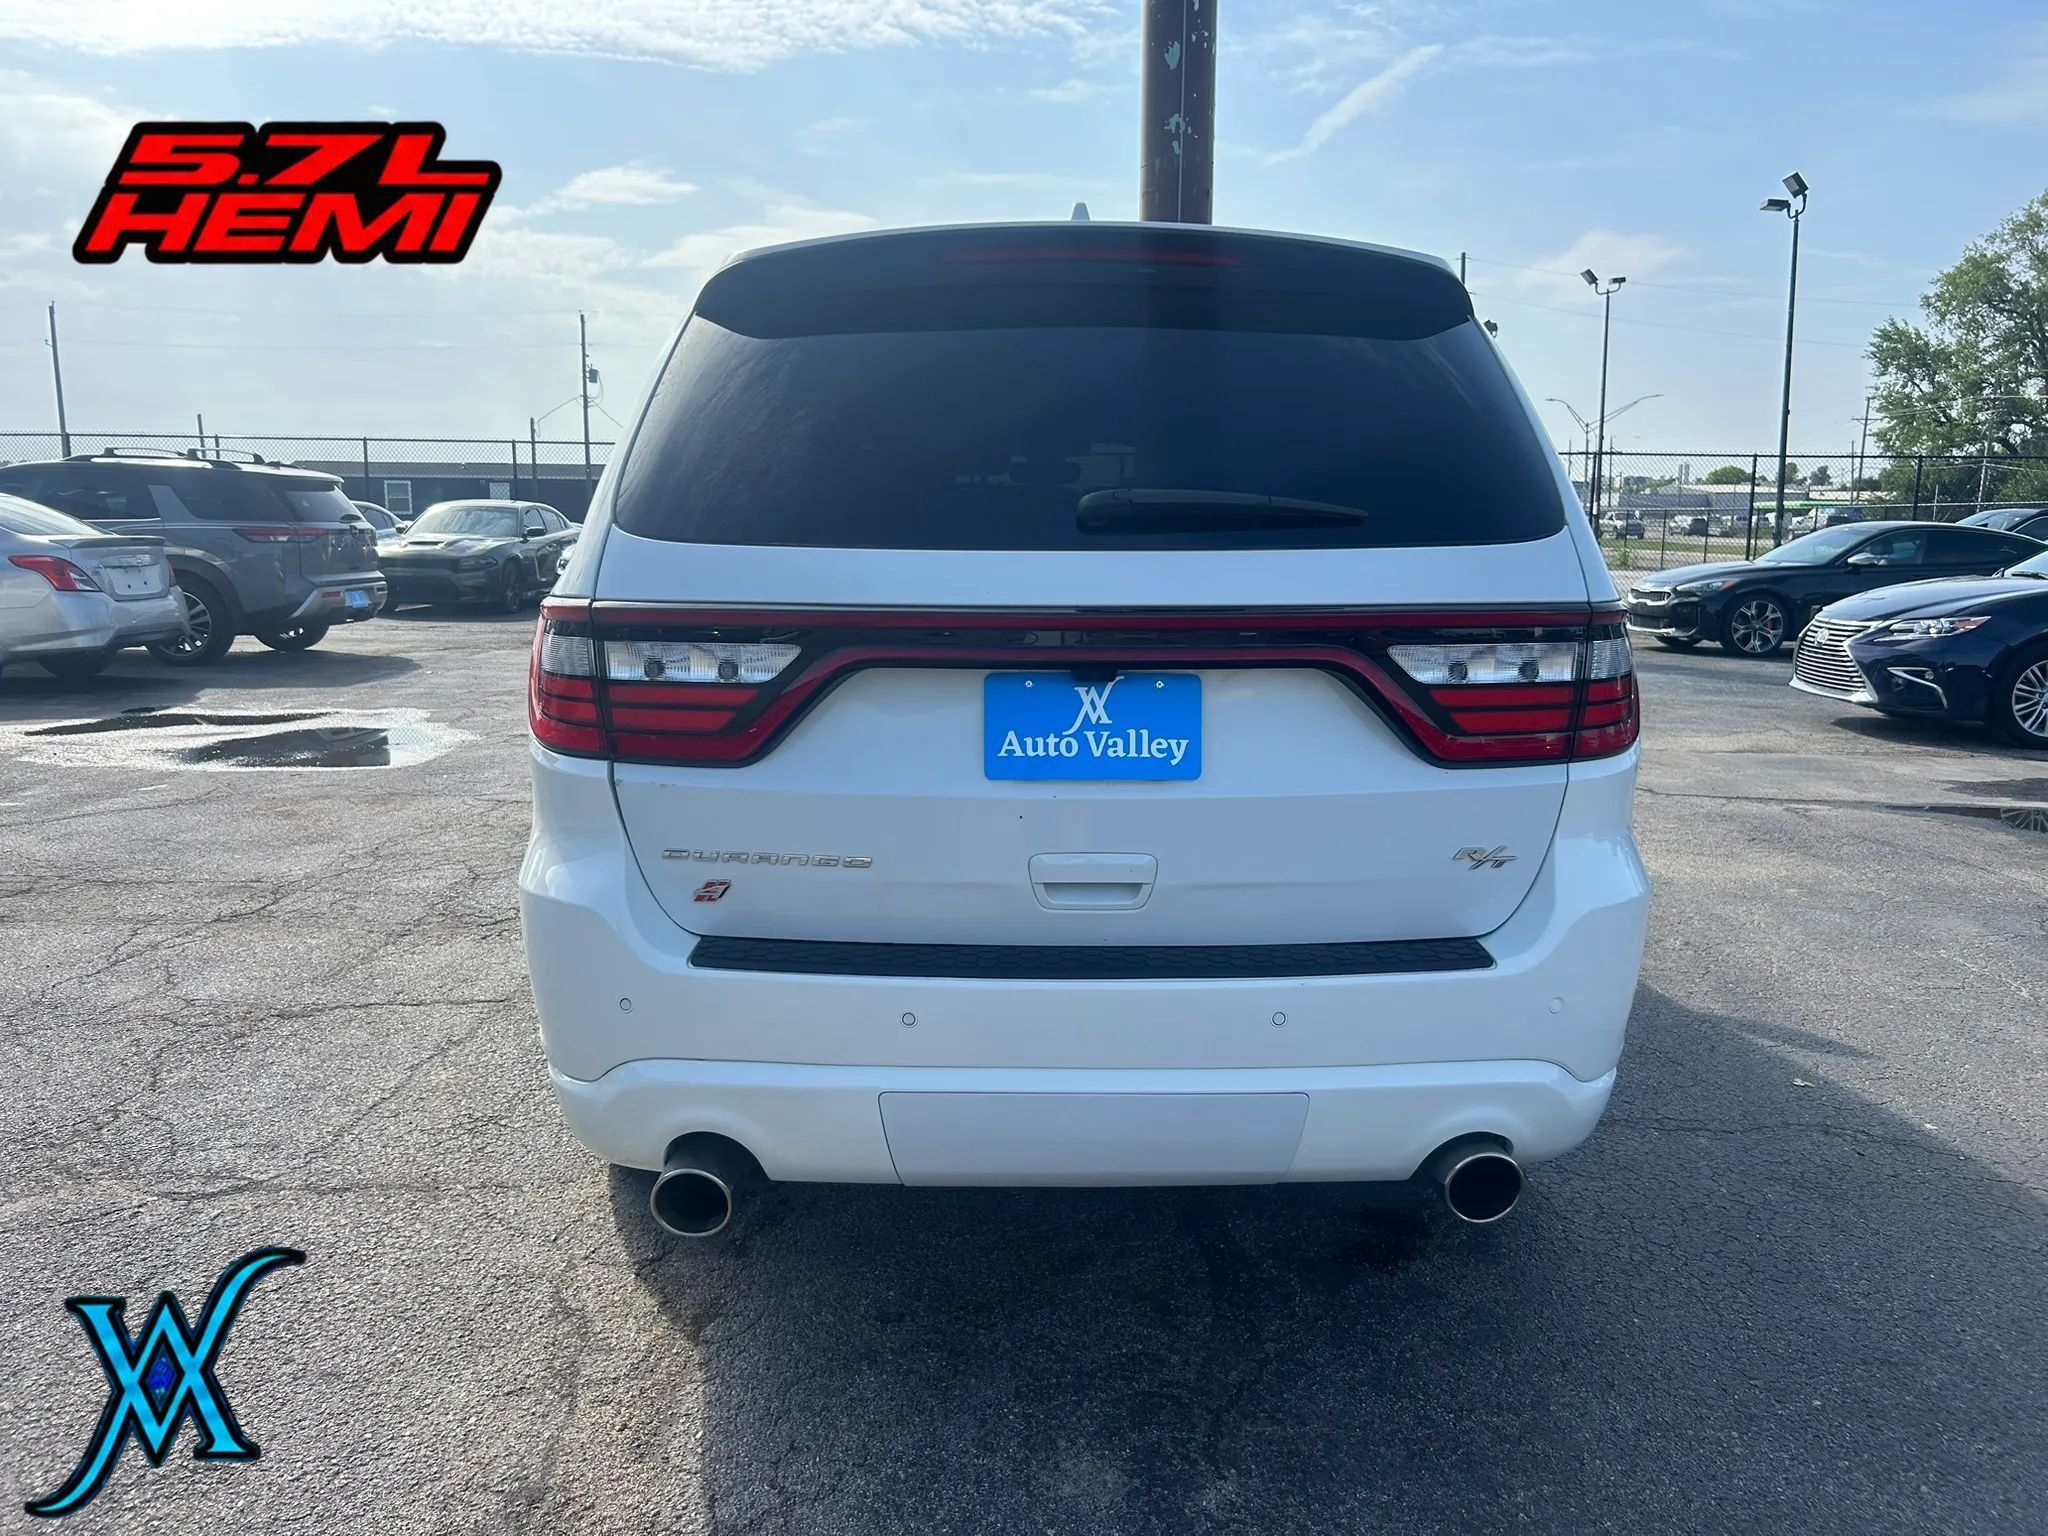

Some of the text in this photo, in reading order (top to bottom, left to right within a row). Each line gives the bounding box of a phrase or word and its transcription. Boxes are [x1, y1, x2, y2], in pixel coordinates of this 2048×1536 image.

[997, 729, 1189, 766] Auto Valley
[661, 849, 873, 868] DURANGO
[1452, 845, 1518, 870] R/T
